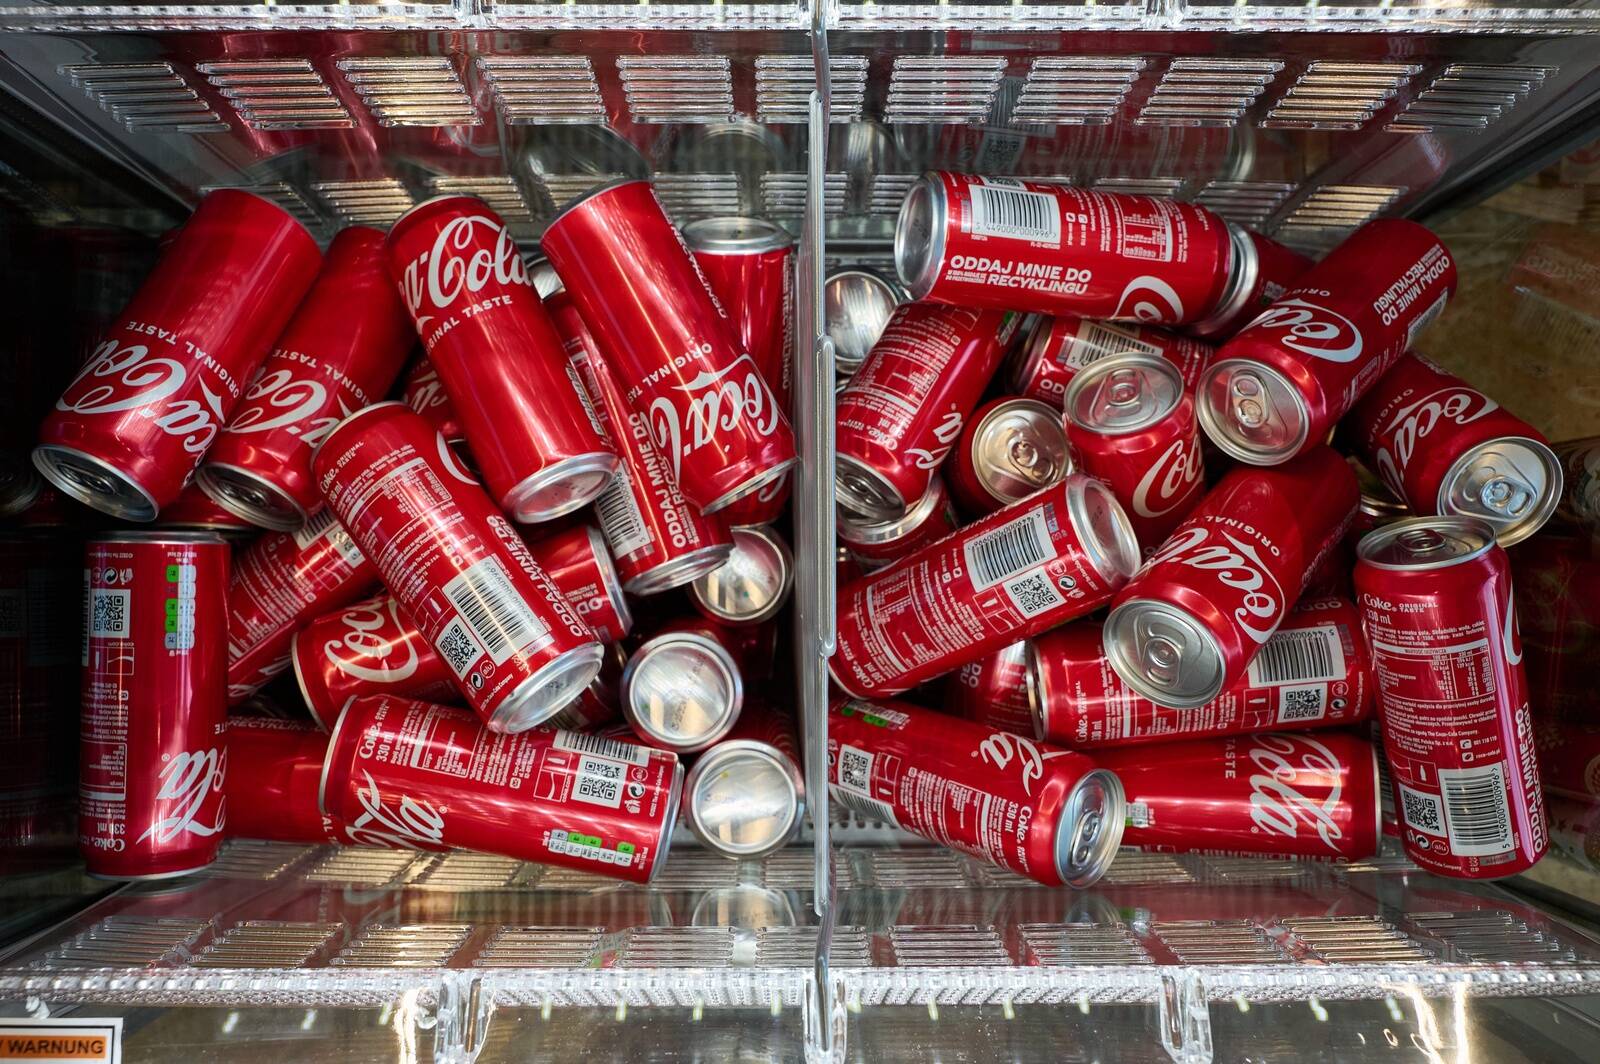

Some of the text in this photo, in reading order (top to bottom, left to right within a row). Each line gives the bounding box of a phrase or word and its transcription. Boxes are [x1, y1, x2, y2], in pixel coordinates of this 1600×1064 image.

[976, 222, 1049, 238] 5 449000 000996
[950, 255, 1092, 283] ODDAJ MNIE DO
[1421, 256, 1450, 290] ODDAJ
[987, 274, 1088, 295] RECYKLINGU
[1374, 261, 1426, 314] RECYKLINGU
[1396, 282, 1421, 312] MNIE
[462, 295, 513, 318] TASTE
[1382, 305, 1398, 326] DO
[126, 321, 239, 399] ORIGINAL TASTE
[642, 343, 712, 387] ORIGINAL
[877, 416, 891, 428] ml
[337, 441, 365, 464] ORIGINAL
[628, 412, 686, 548] ODDAJ MNIE DO
[487, 514, 507, 540] DO
[1206, 515, 1280, 557] ORIGINAL
[505, 540, 540, 584] MNIE
[536, 580, 582, 637] ODDAJ
[1364, 593, 1392, 611] Coke
[1380, 614, 1392, 625] ml
[482, 664, 494, 674] alu
[852, 661, 875, 687] Coke
[865, 661, 876, 674] ml
[1074, 717, 1088, 742] Coke
[1092, 719, 1102, 729] ml
[358, 722, 380, 760] Coke
[375, 743, 389, 761] 330
[1492, 774, 1504, 808] 000996
[1515, 709, 1543, 852] ODDAJ MNIE DO
[96, 822, 125, 833] 330 ml
[1004, 802, 1017, 832] 330 ml
[1018, 804, 1032, 833] Coke
[1497, 808, 1510, 841] 449000
[94, 837, 125, 851] Coke
[9, 1040, 103, 1054] WARNUNG
